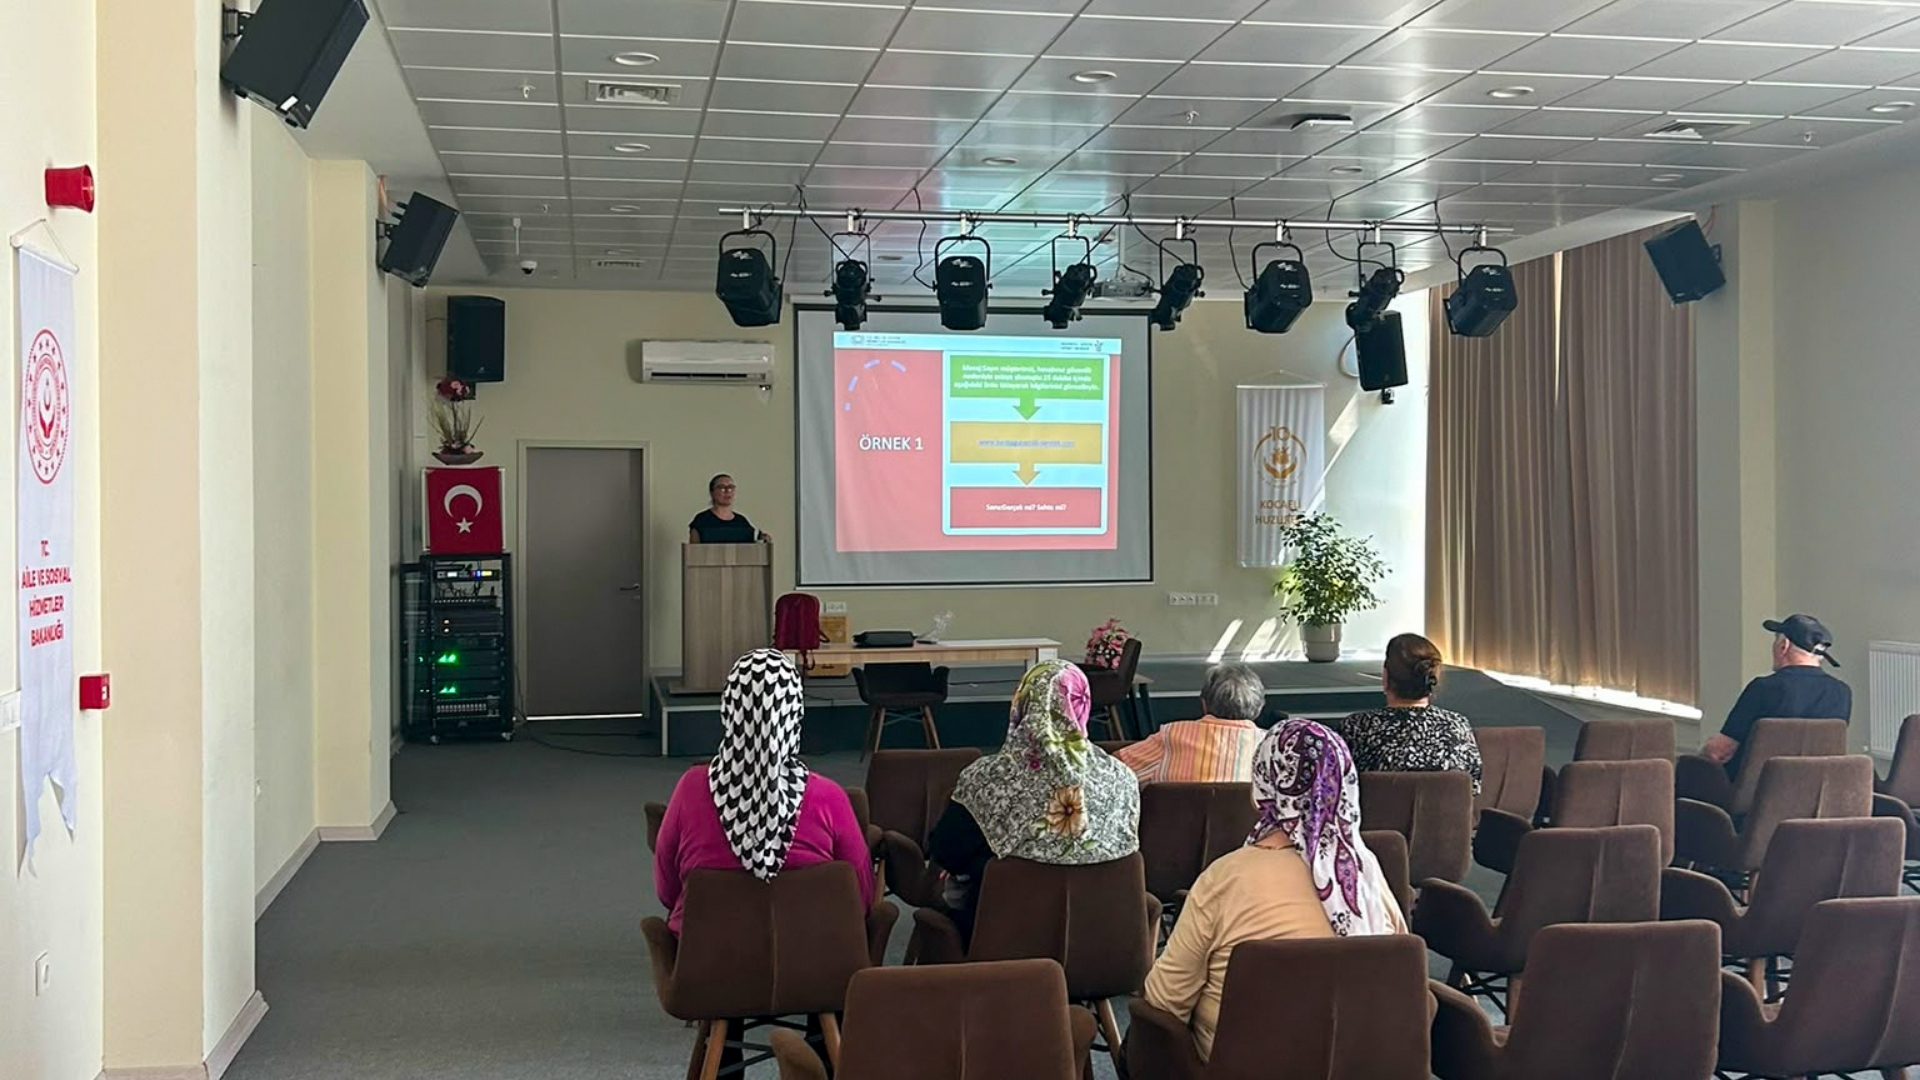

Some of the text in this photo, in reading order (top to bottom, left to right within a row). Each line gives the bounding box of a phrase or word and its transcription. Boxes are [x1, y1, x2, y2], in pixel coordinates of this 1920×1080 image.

[859, 433, 924, 451] ÖRNEK 1
[46, 567, 71, 584] SOSYAL
